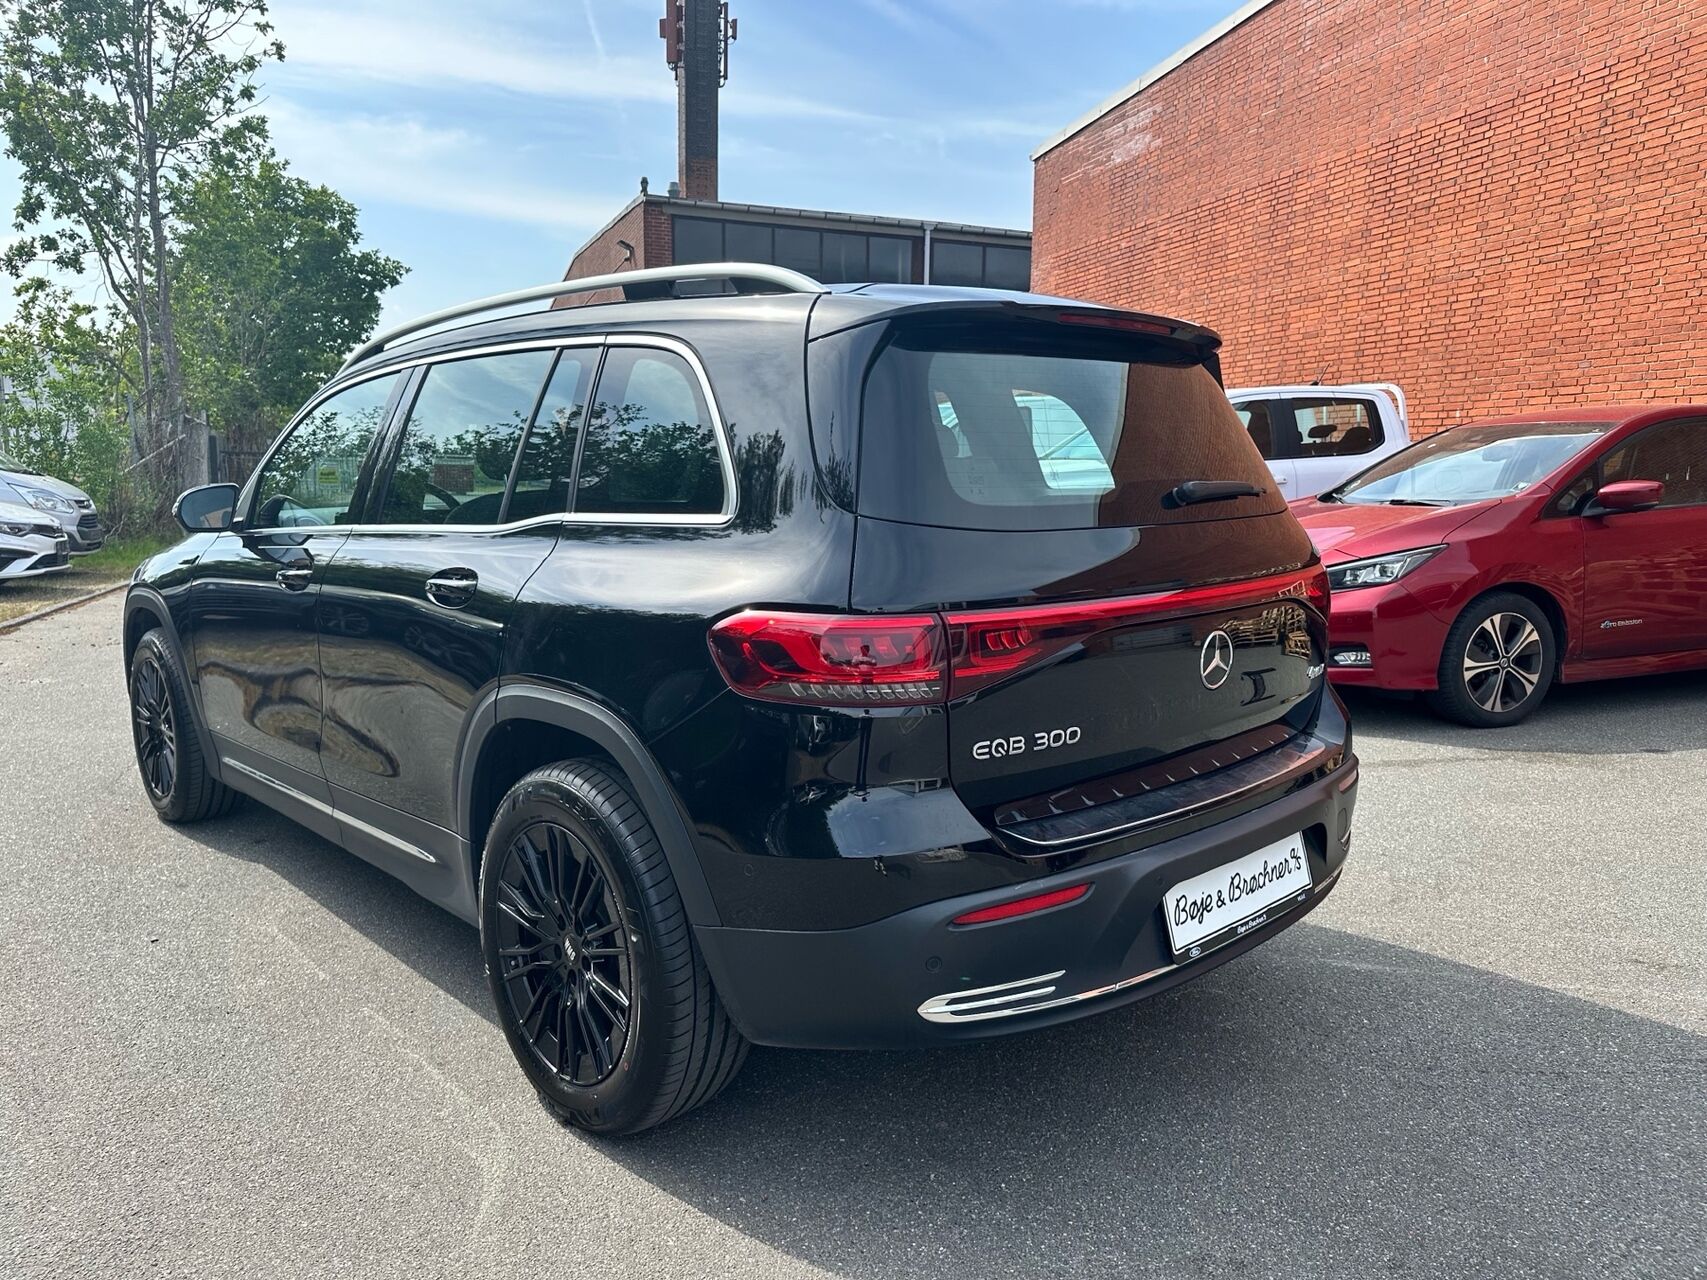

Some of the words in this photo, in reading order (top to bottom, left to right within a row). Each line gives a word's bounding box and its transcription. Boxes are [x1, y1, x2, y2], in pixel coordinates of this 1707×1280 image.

[972, 736, 1026, 760] EQB
[1033, 726, 1081, 751] 300
[1174, 892, 1213, 927] Bøje
[1216, 890, 1227, 908] &
[1228, 860, 1292, 903] Brøchner
